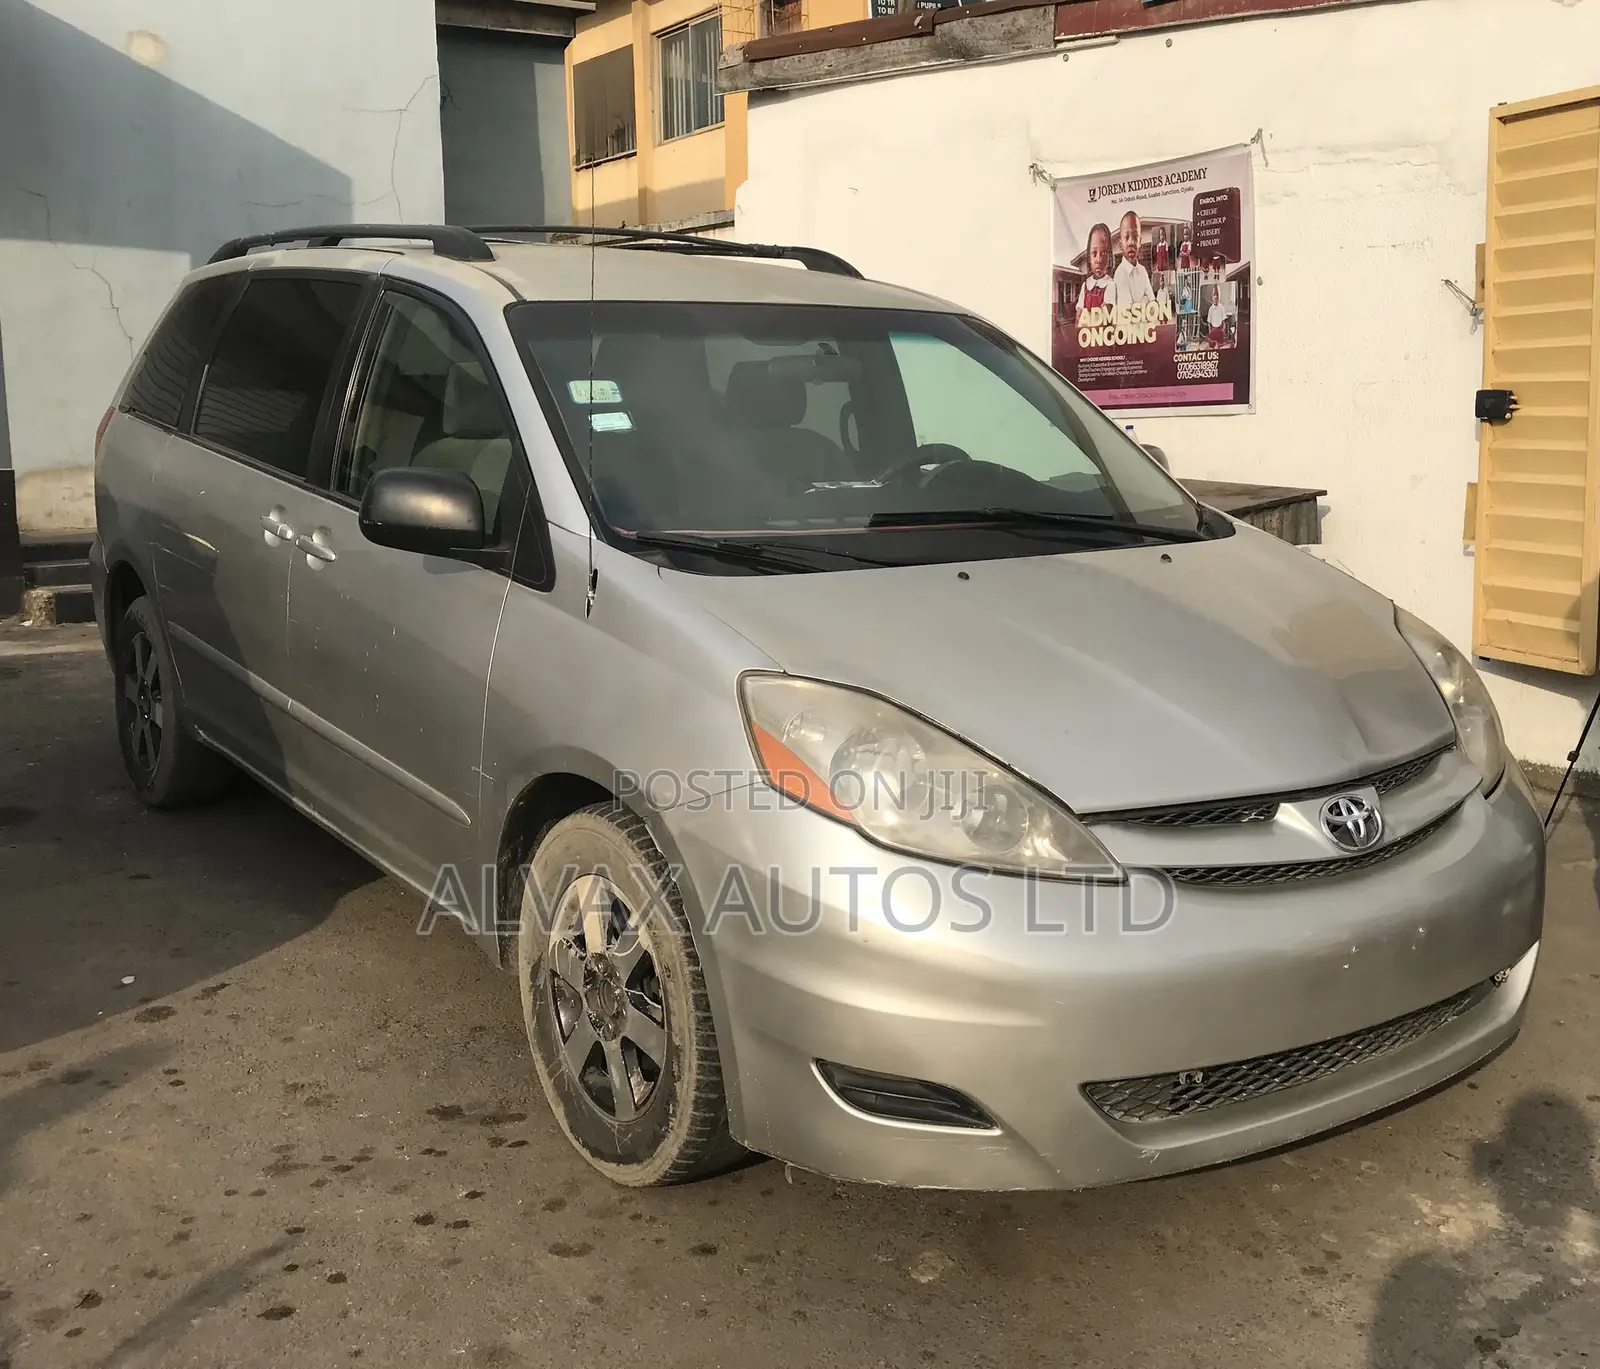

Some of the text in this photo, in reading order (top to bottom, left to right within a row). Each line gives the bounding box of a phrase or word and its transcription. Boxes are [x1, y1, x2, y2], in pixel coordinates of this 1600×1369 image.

[877, 6, 887, 14] TO
[1098, 167, 1208, 200] JOREM KIDDIES ACADEMY
[1199, 194, 1229, 205] ENROL INTO:
[1200, 216, 1227, 227] PLAYGROUP
[1200, 228, 1221, 237] NURSERY
[1200, 238, 1221, 247] PRIMARY
[1078, 299, 1172, 328] ADMISSION
[1078, 323, 1157, 348] ONGOING
[1173, 351, 1219, 362] CONTACT US:
